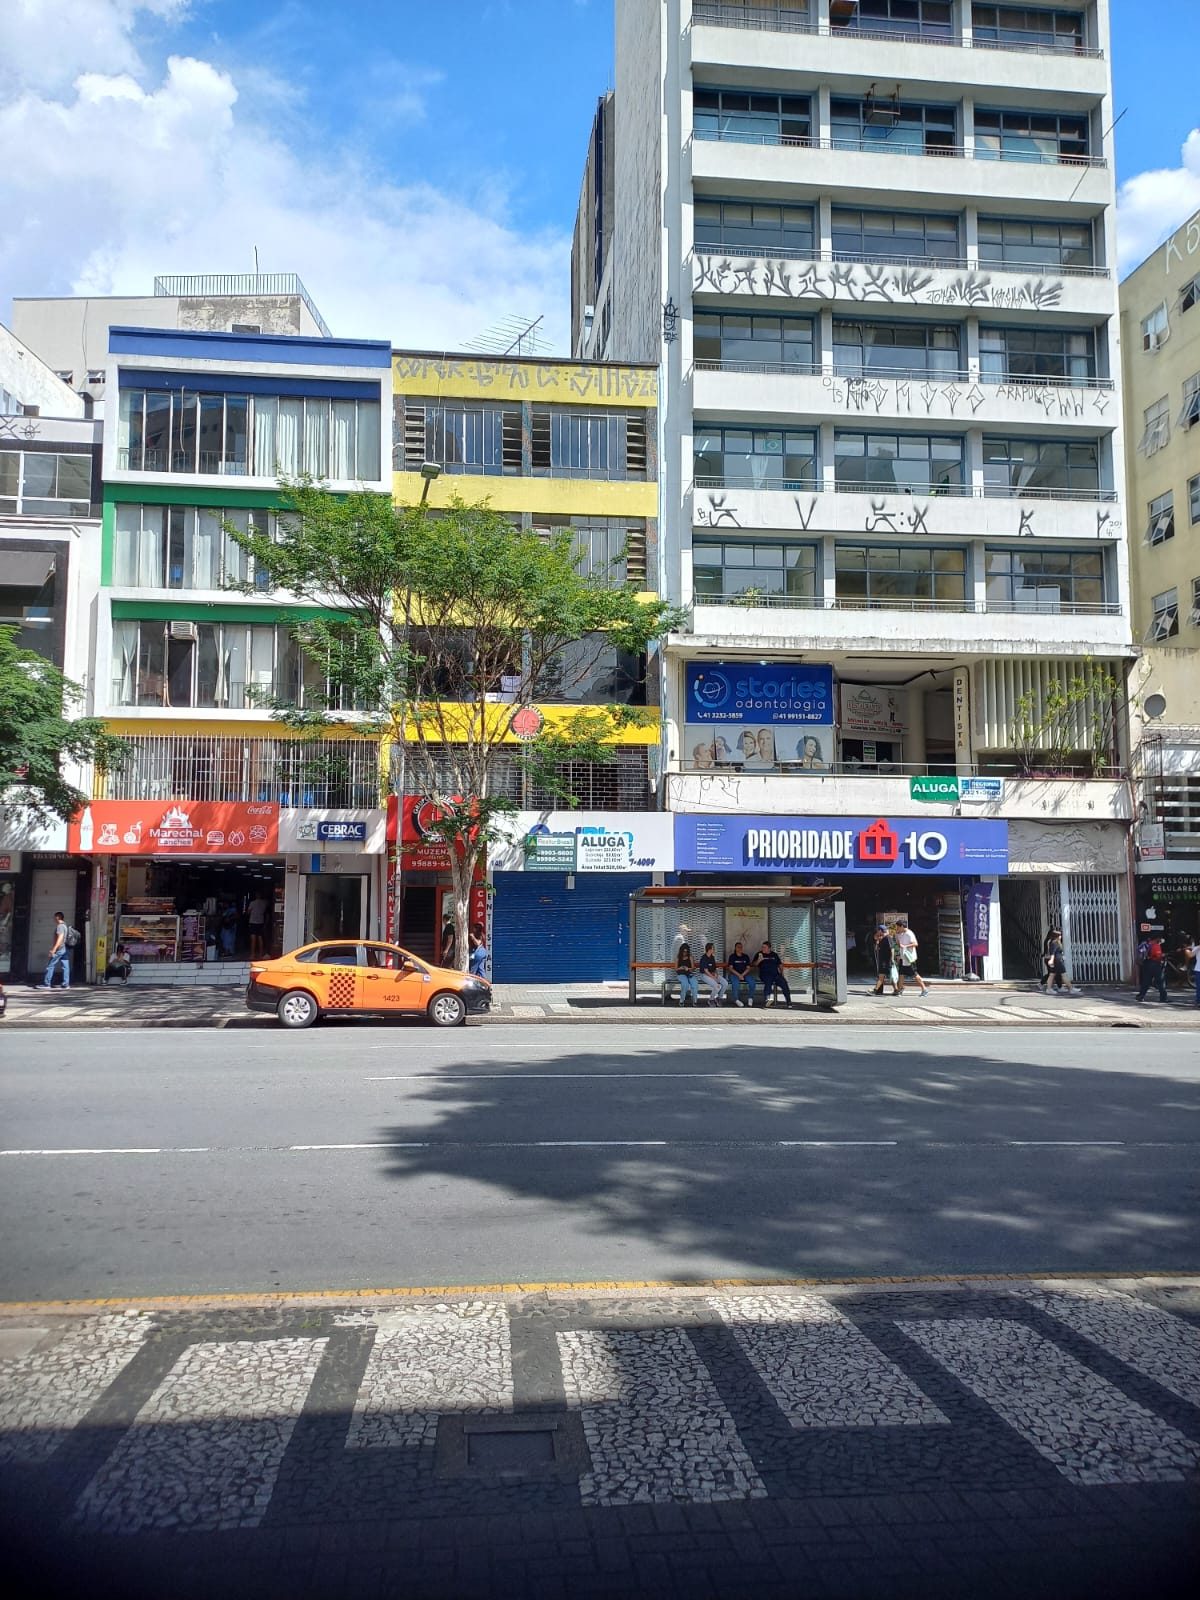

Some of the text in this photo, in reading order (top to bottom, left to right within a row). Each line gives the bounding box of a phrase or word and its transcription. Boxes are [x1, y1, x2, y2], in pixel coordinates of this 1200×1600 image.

[735, 676, 827, 698] stories
[735, 698, 826, 711] odontologia
[912, 783, 958, 793] ALUGA
[149, 828, 203, 838] Marechal
[321, 824, 363, 835] CEBRAC
[581, 836, 626, 847] ALUGA
[748, 829, 854, 859] PRIORIDADE
[904, 831, 948, 861] 10
[978, 903, 988, 940] R$20
